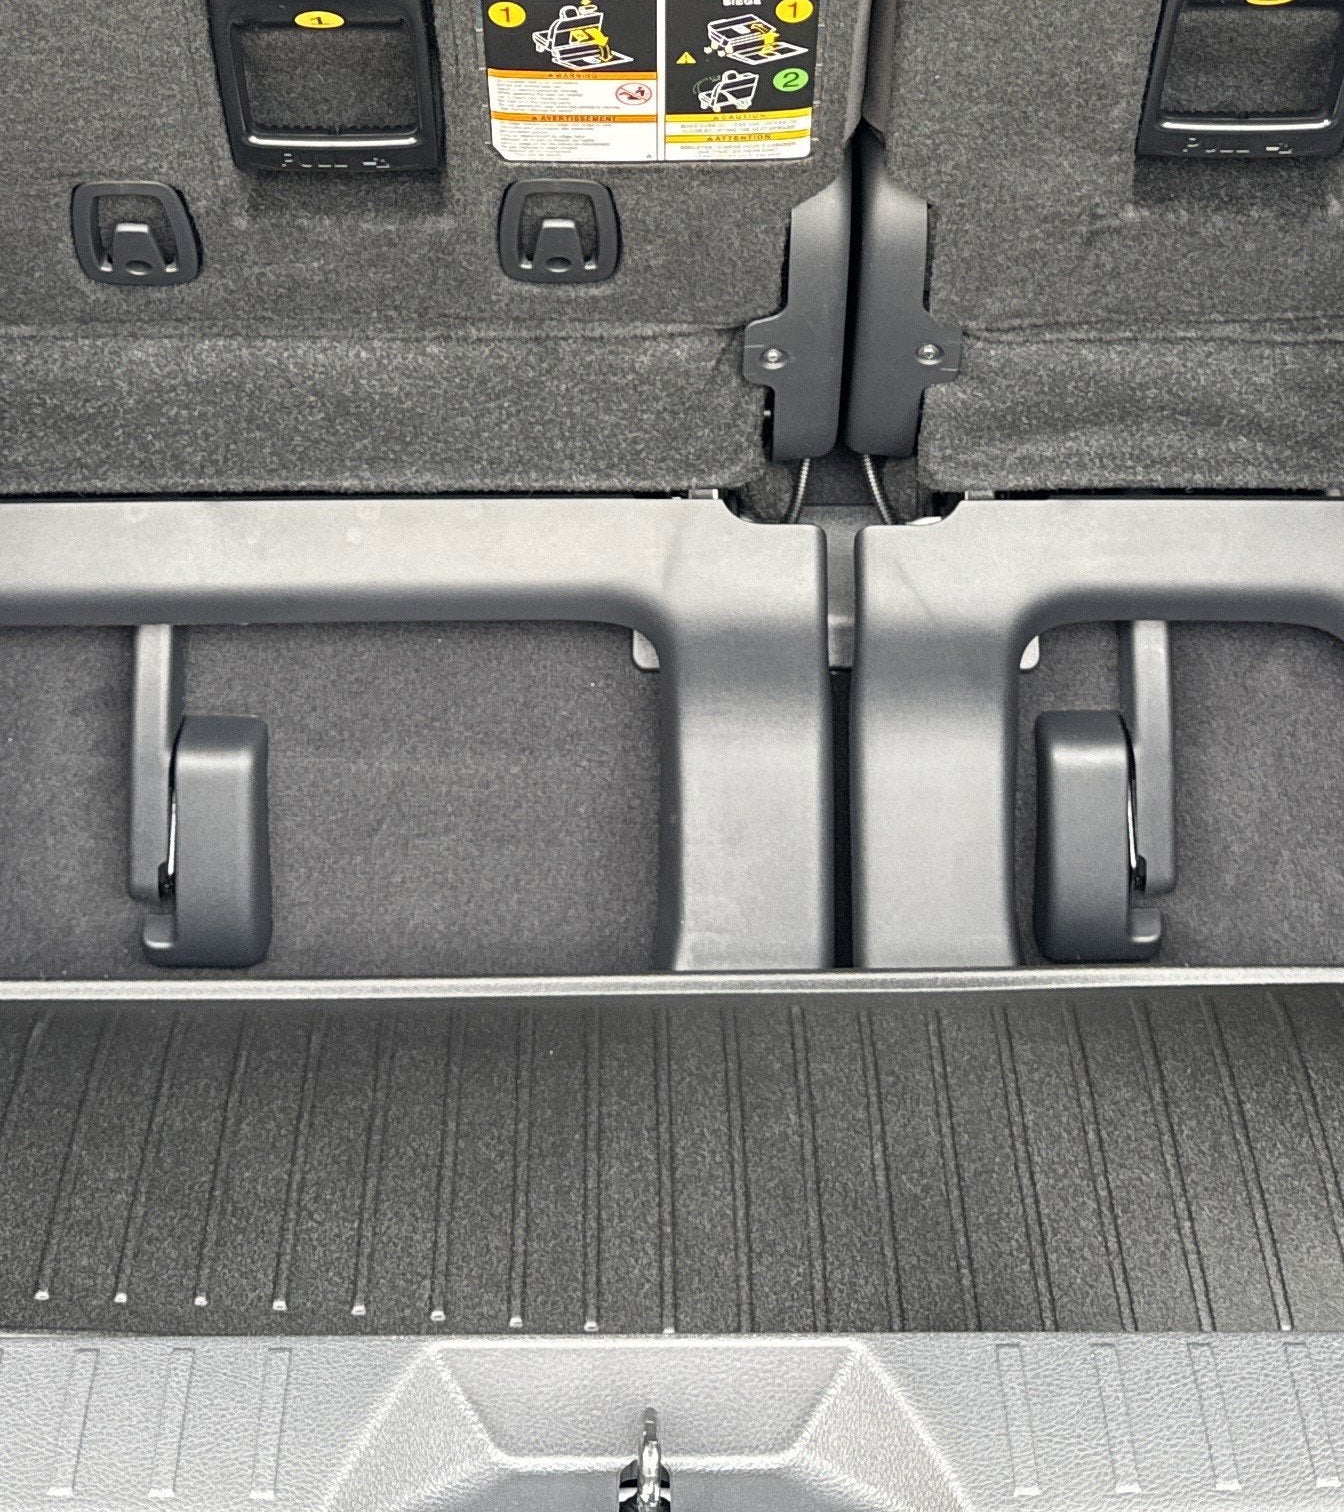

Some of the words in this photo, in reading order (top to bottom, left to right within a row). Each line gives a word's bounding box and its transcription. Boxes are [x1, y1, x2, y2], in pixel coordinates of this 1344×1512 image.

[499, 6, 511, 23] 1
[787, 1, 798, 19] 1
[783, 71, 799, 88] 2
[716, 134, 771, 142] ATTENTION
